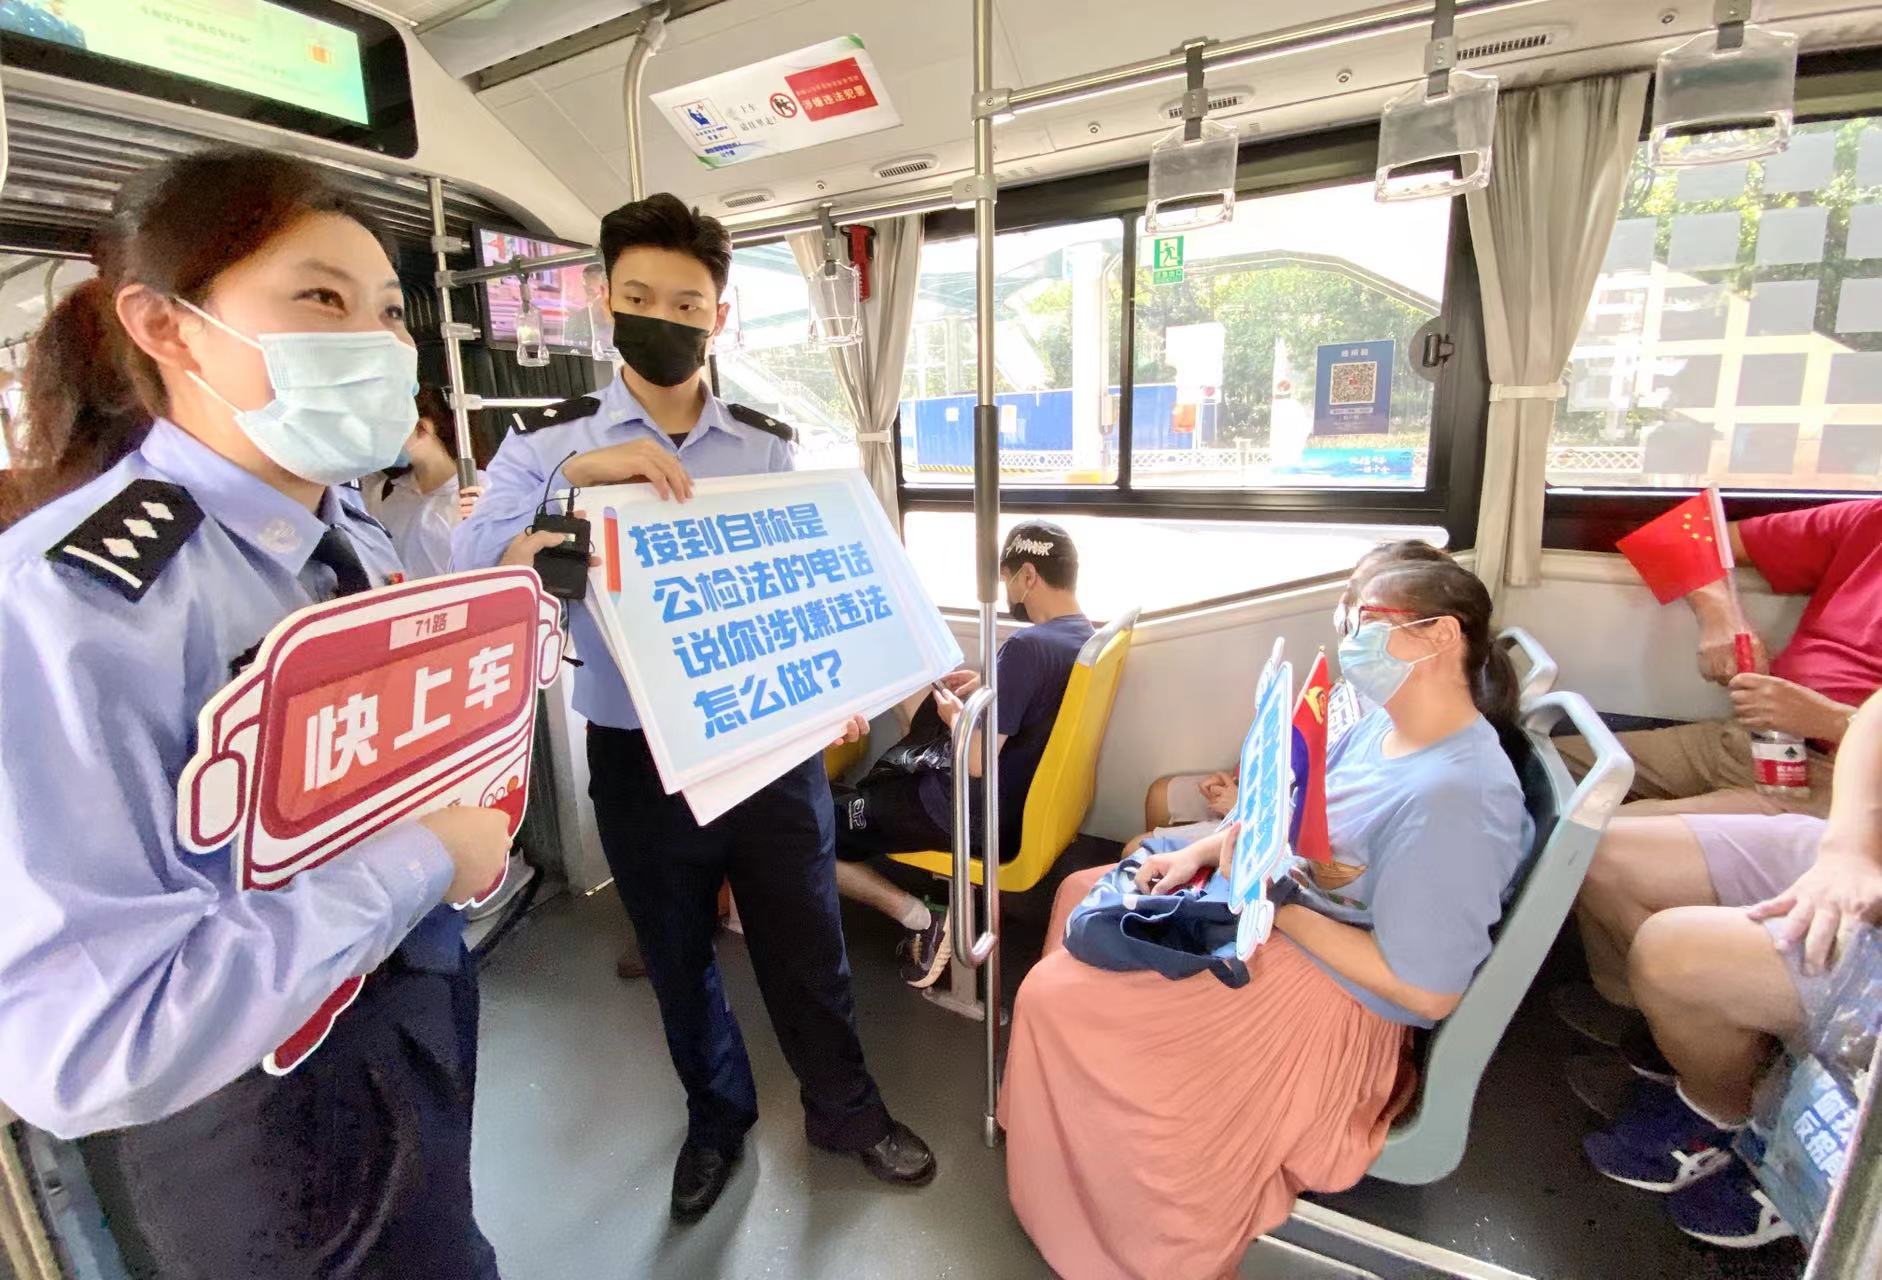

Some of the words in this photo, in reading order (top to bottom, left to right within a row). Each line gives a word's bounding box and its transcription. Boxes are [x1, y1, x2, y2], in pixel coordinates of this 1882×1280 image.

[628, 502, 829, 568] 接到自称是
[414, 611, 449, 637] 71路
[652, 541, 875, 624] 公检法的电话
[672, 584, 893, 679] 说你涉嫌违法
[303, 642, 515, 793] 快上车
